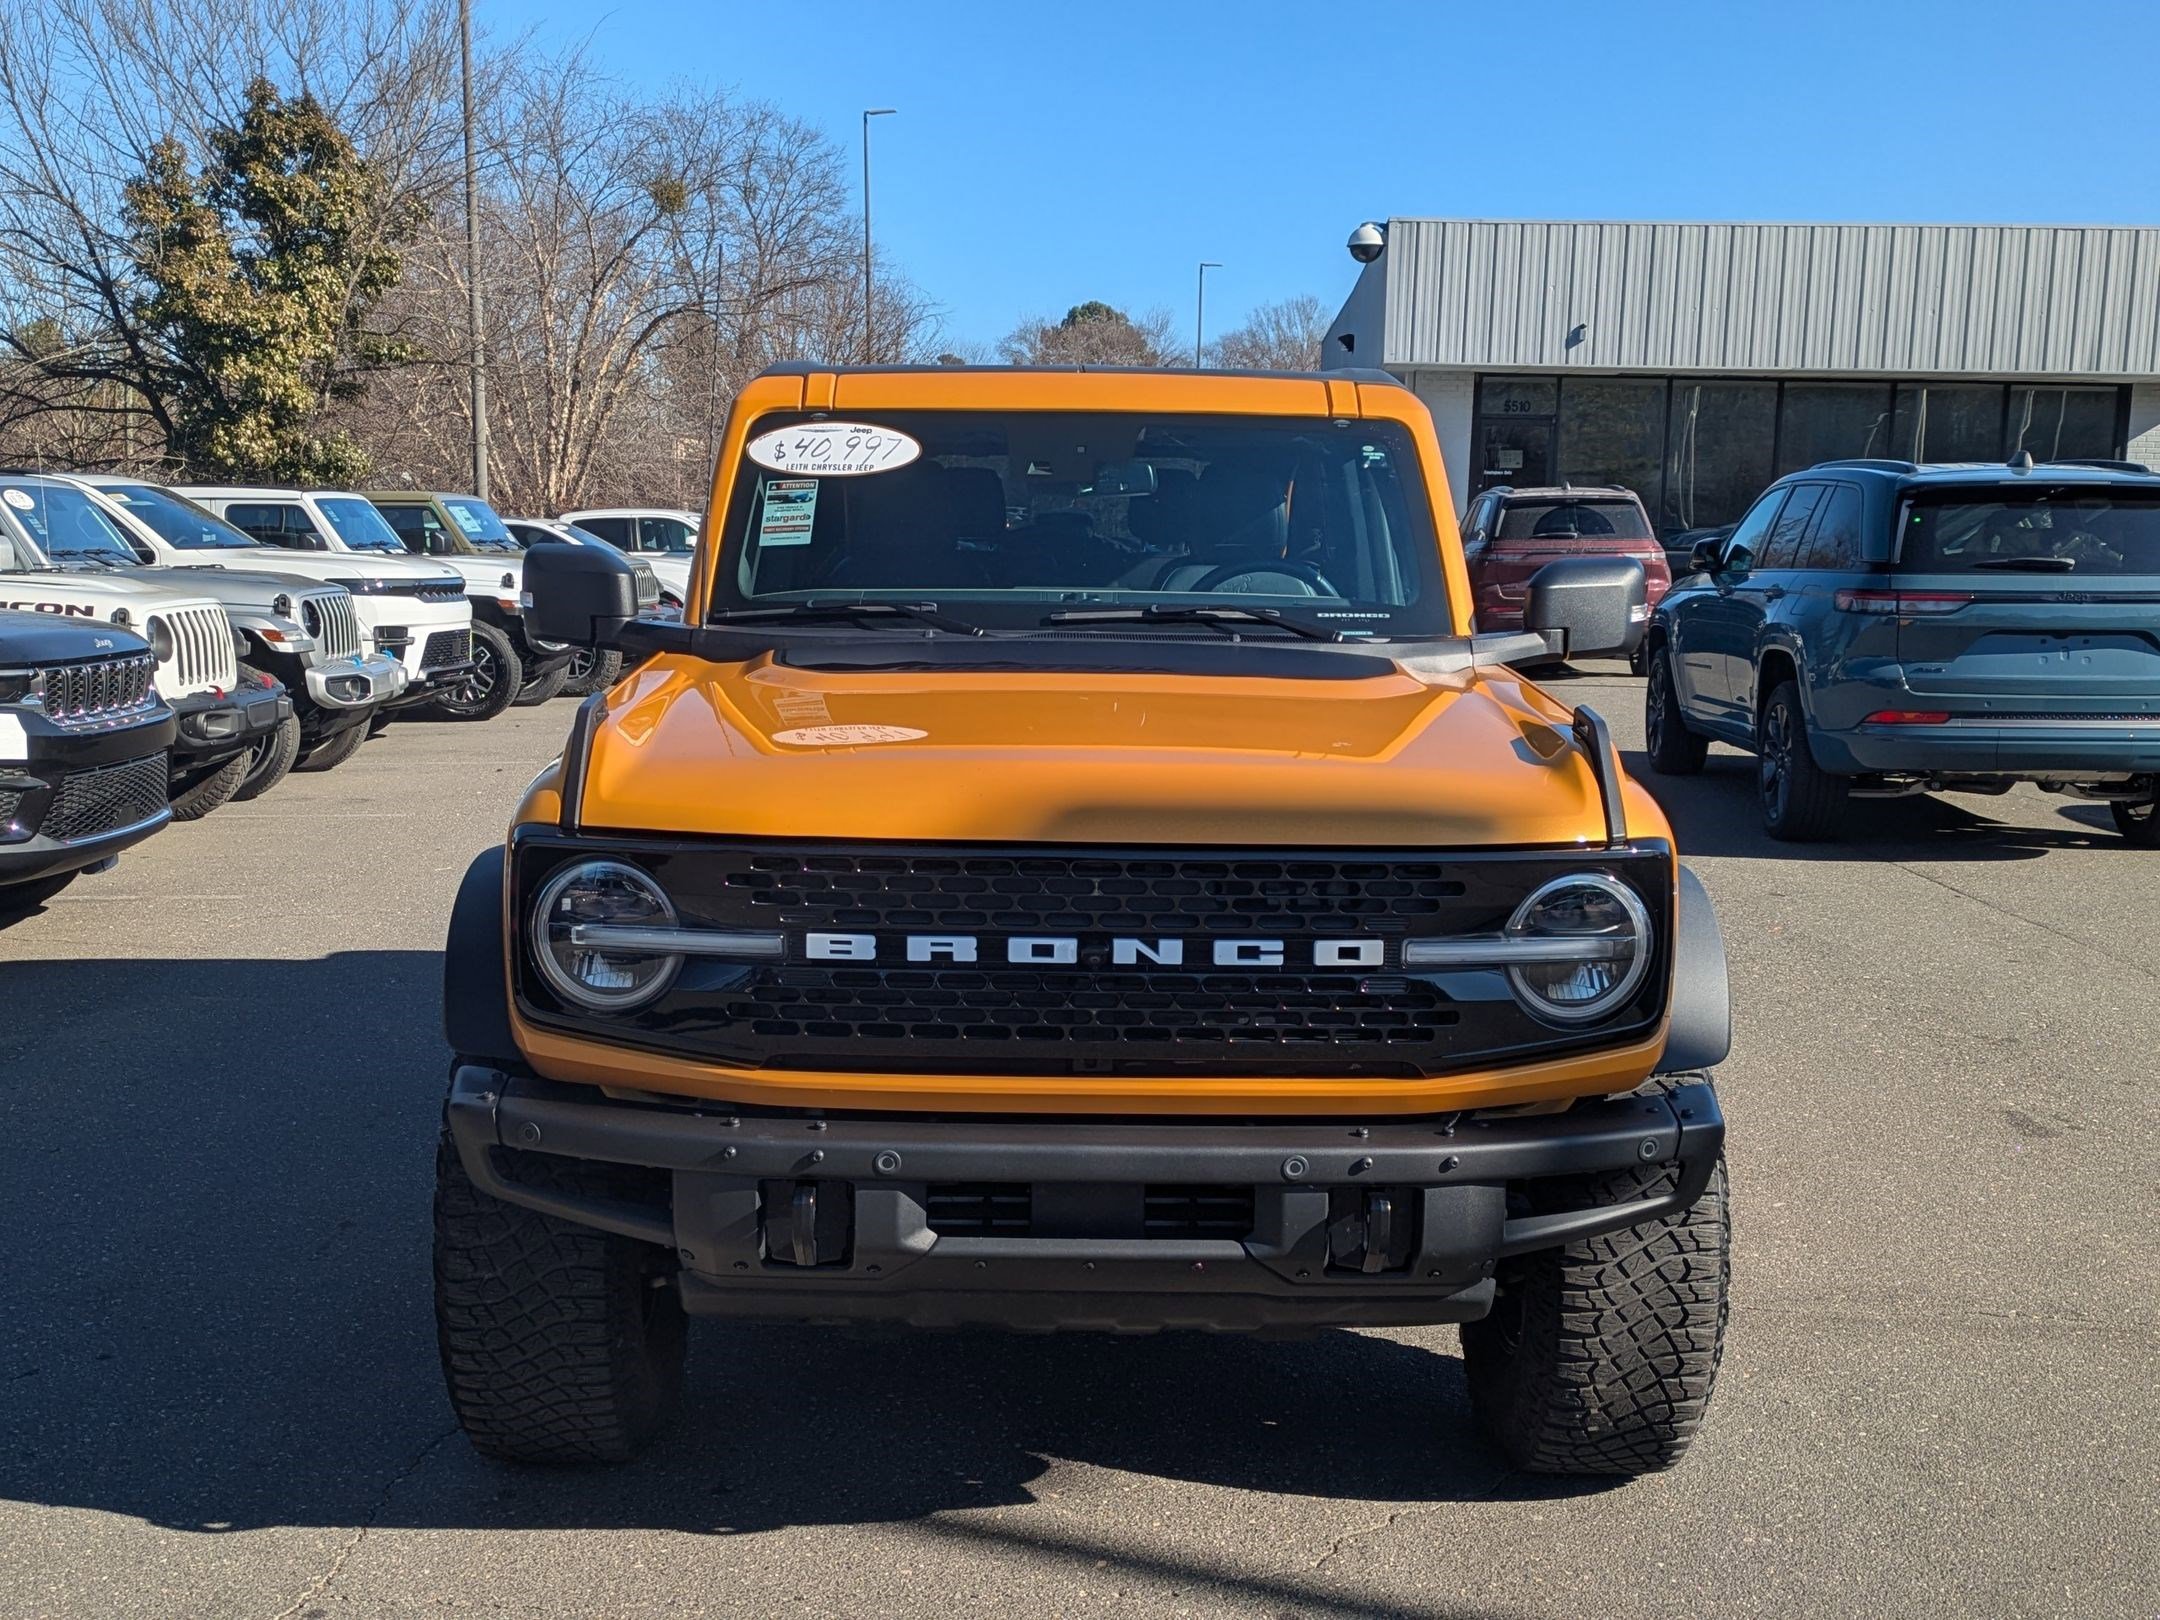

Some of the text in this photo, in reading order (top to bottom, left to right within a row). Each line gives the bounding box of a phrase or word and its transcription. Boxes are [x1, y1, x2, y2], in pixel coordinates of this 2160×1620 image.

[1504, 400, 1531, 412] 5510
[785, 463, 809, 471] LEITH
[811, 463, 853, 471] CHRYSLER
[806, 933, 1384, 967] BRONCO
